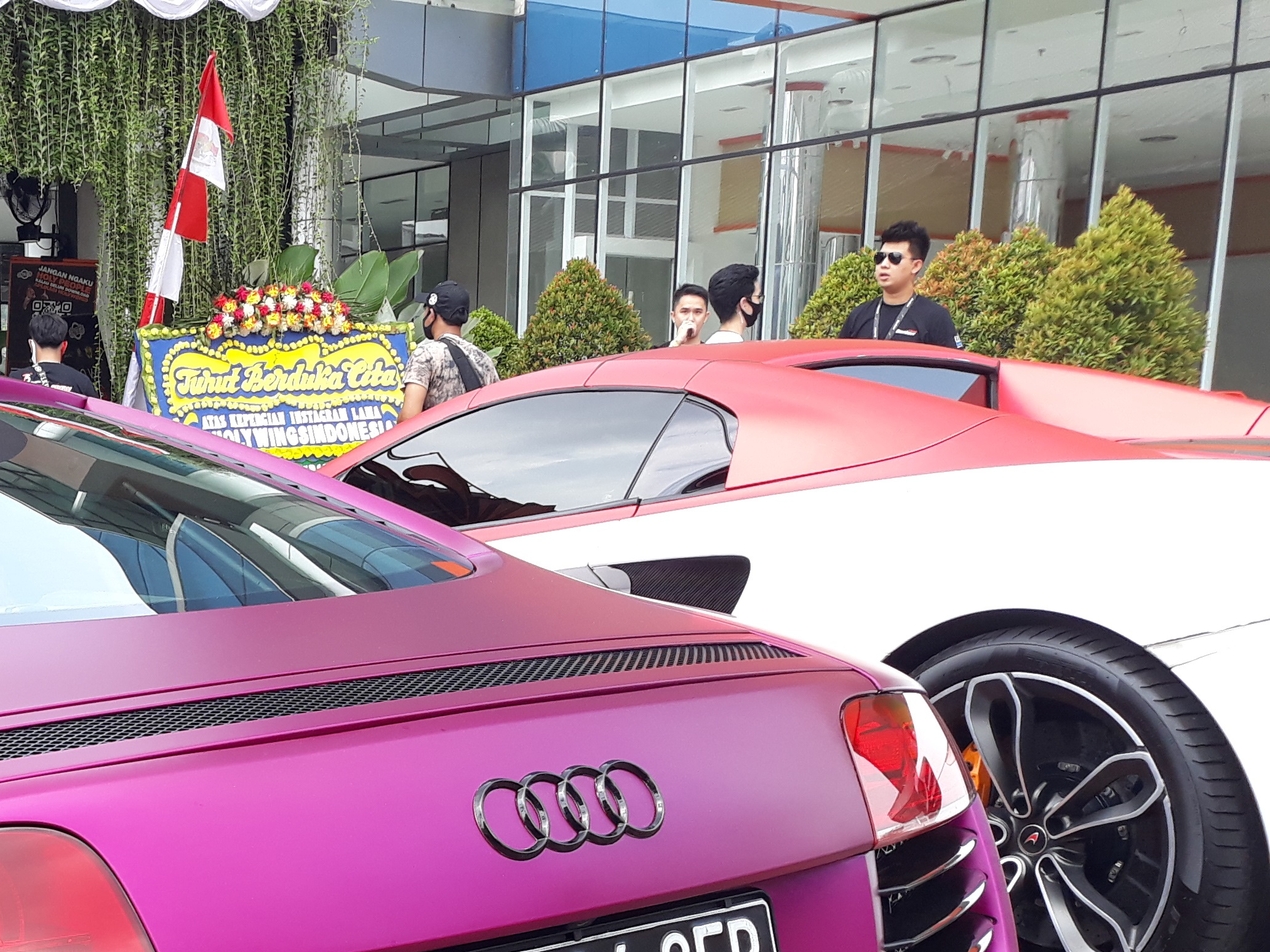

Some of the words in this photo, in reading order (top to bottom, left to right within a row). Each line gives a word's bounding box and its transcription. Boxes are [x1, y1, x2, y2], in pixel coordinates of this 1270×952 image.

[36, 272, 58, 282] HOLY
[59, 278, 92, 294] PEOPLE
[38, 266, 67, 279] JANGAN
[68, 274, 94, 287] NGAKU
[176, 366, 242, 395] Turut
[241, 361, 344, 393] Berduka
[344, 359, 399, 389] Cita
[202, 414, 227, 430] ATAS
[289, 407, 349, 424] INSTAGRAM
[351, 405, 382, 421] LAMA
